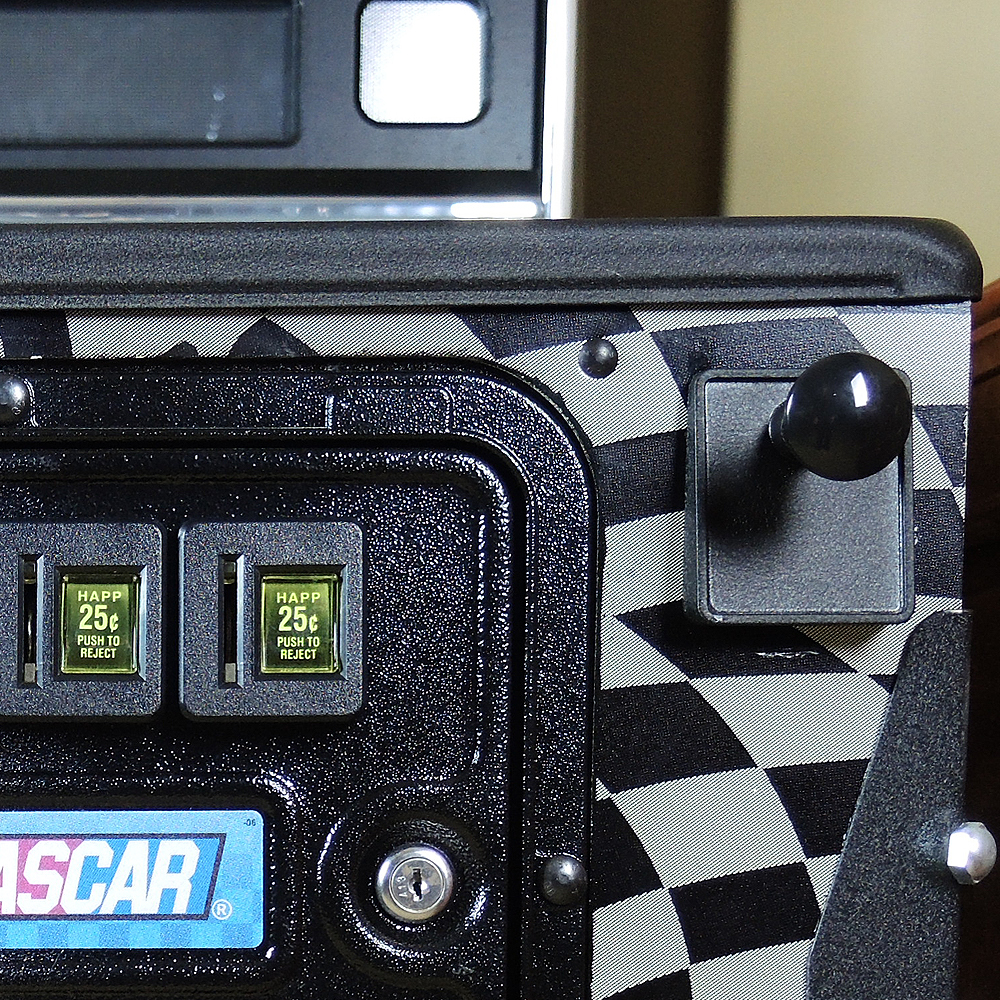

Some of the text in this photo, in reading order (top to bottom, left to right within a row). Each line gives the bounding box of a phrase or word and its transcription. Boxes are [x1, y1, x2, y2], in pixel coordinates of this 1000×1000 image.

[77, 590, 122, 602] HAPP
[276, 592, 321, 604] HAPP
[79, 603, 119, 633] 25¢
[278, 605, 318, 634] 25¢
[77, 634, 121, 647] PUSH TO
[277, 636, 321, 648] PUSH TO
[80, 647, 117, 659] REJECT
[280, 648, 317, 660] REJECT
